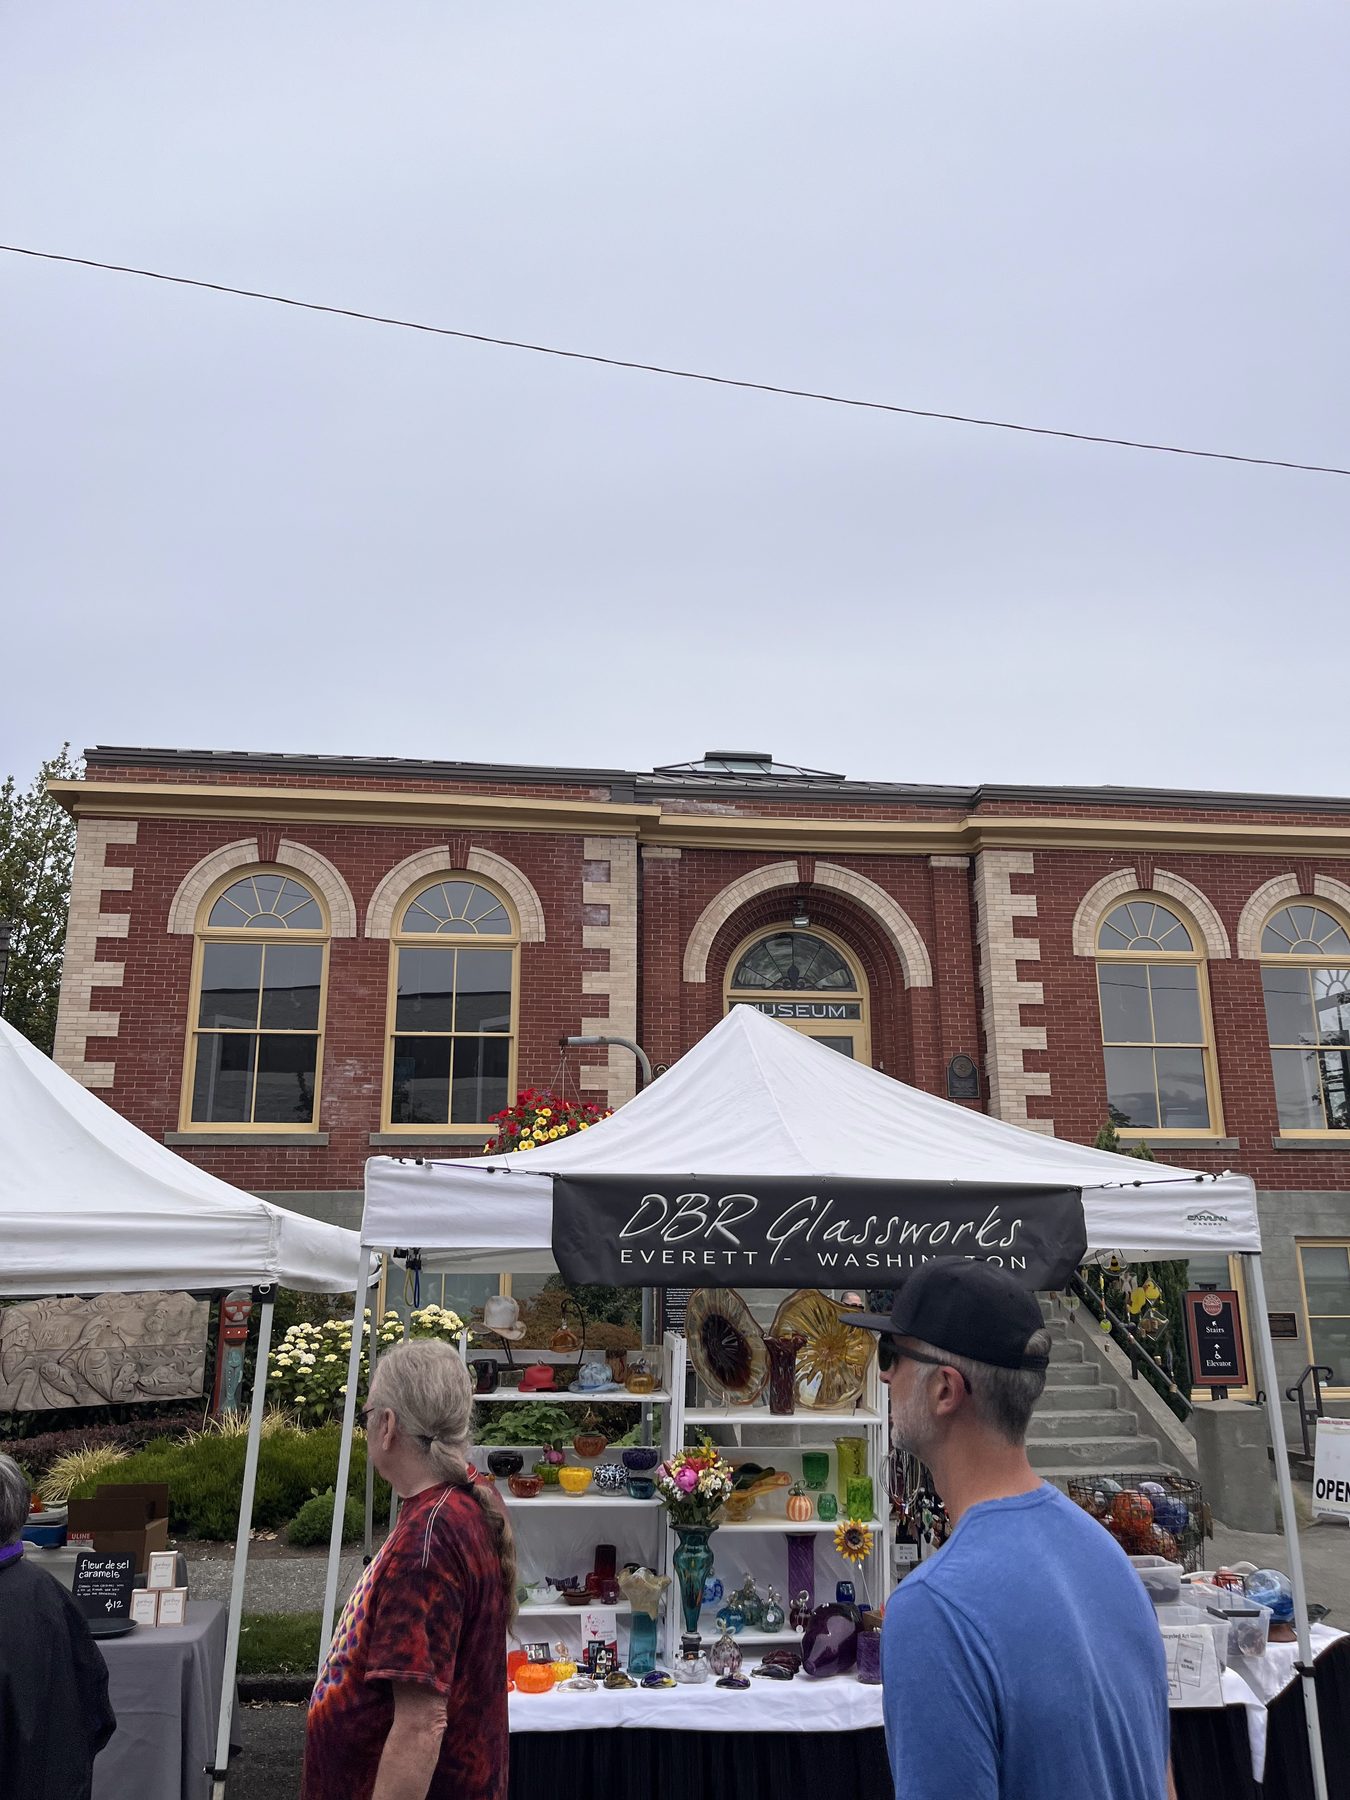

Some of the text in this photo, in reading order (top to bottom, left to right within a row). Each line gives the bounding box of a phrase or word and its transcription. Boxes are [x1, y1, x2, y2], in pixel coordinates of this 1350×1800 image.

[753, 1004, 846, 1018] USEUM
[619, 1193, 1022, 1265] DBR Glassworks
[620, 1249, 758, 1265] EVERETT
[80, 1559, 130, 1571] fleur de sel
[79, 1570, 120, 1579] caramels
[105, 1599, 124, 1612] $12
